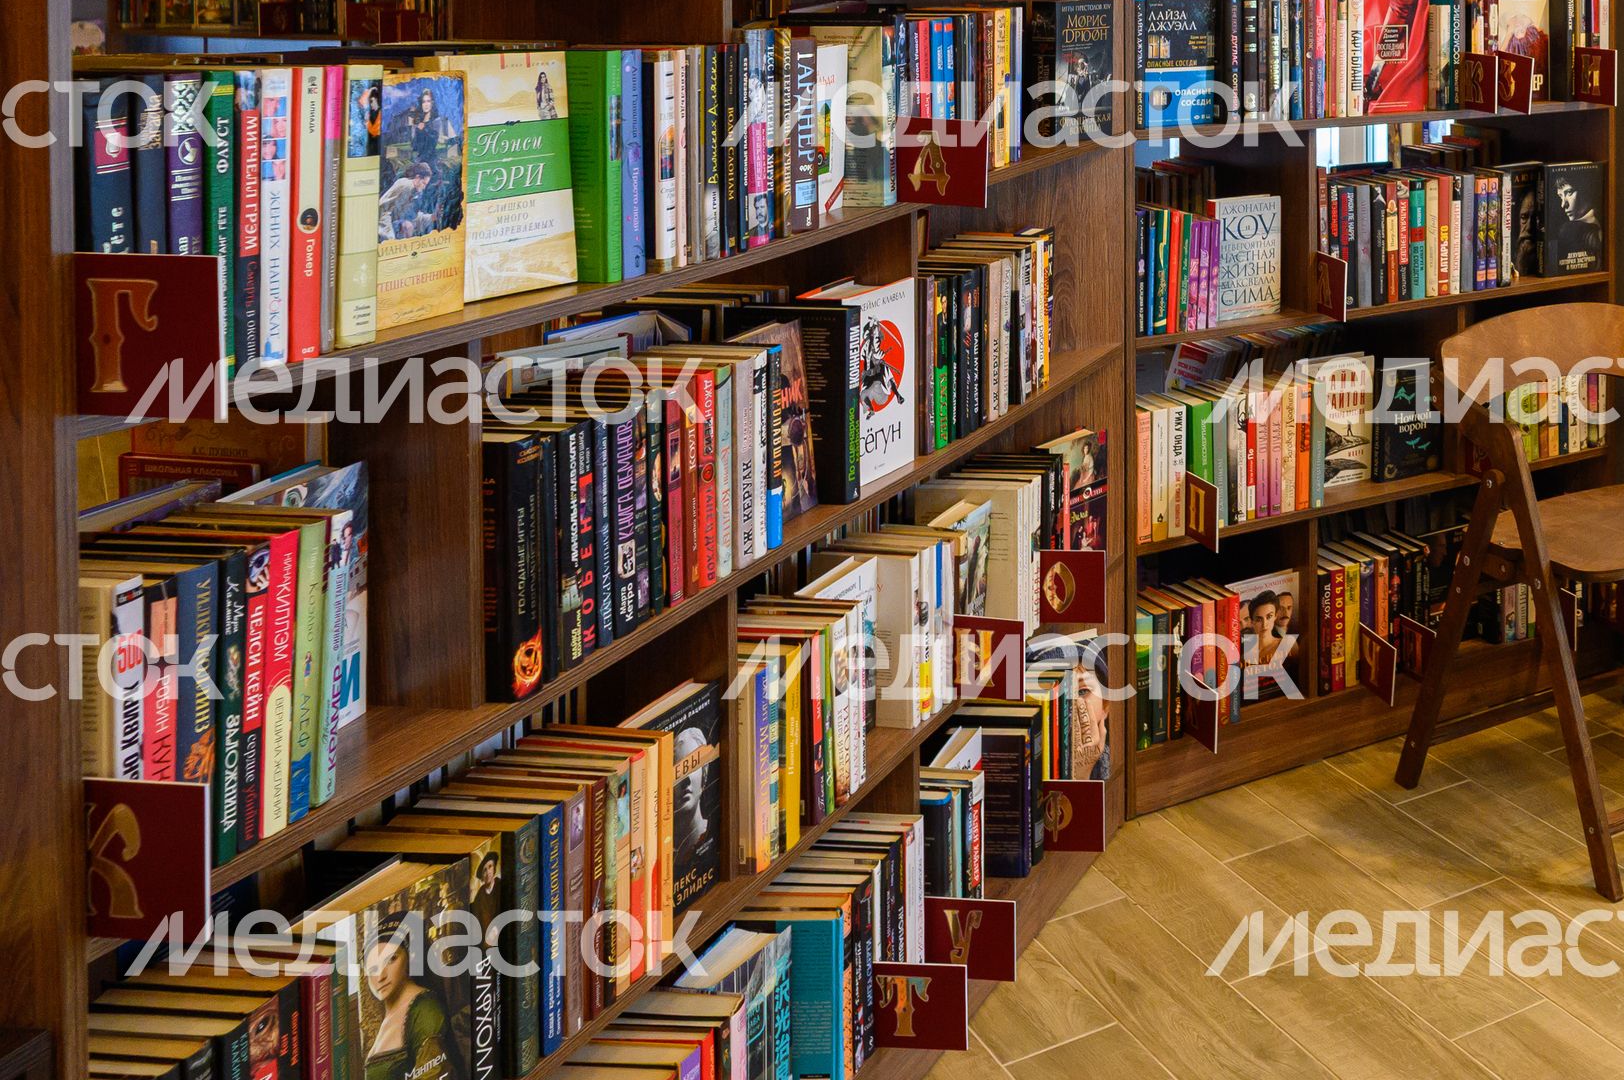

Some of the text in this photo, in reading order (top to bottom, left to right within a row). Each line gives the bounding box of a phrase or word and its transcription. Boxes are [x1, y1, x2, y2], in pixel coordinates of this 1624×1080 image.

[1147, 9, 1188, 22] ЛАЙЗА
[1147, 20, 1198, 33] ДЖУЭЛЛ
[1452, 3, 1461, 66] КОСМОПОЛИС
[1146, 59, 1198, 68] ОПАСНЫЕ СОСЕДИ
[1174, 88, 1212, 98] ОПАСНЫЕ
[1181, 98, 1212, 108] СОСЕДИ
[215, 117, 231, 175] ФАУСТ
[472, 131, 544, 157] Нэнси
[244, 114, 259, 251] МИТЧЕЛЛ ГРЭМ
[474, 163, 545, 195] ГЭРИ
[268, 189, 282, 250] ЖЕНИХ
[487, 199, 537, 215] СЛИШКОМ
[495, 212, 530, 226] МНОГО
[1221, 201, 1277, 215] ДЖОНАТАН
[471, 218, 555, 241] ПОДОЗРЕВАЕМЫХ
[1221, 213, 1277, 242] КОУ
[303, 238, 316, 277] Гомер
[1220, 239, 1277, 253] НЕВЕРОЯТНАЯ
[1221, 249, 1276, 265] ЧАСТНАЯ
[1220, 262, 1277, 279] ЖИЗНЬ
[1220, 286, 1276, 308] СИМА
[85, 278, 159, 393] Г
[1394, 409, 1432, 425] Ночной
[1399, 420, 1427, 434] ворон
[1175, 410, 1183, 457] РИКУ ОНДА
[688, 428, 697, 471] КОУЛ
[616, 419, 637, 541] КНИГА ОБМАНОВ
[742, 459, 754, 525] КЕРУАК
[283, 552, 293, 583] НИНА
[619, 586, 629, 615] Марта
[625, 582, 635, 623] Кетро
[246, 605, 265, 721] ЧЕЛСИ КЕЙН
[155, 674, 171, 732] РОБИН
[326, 663, 342, 771] КРАМЕР
[299, 693, 312, 748] АЛЕФ
[243, 733, 258, 783] сердце
[221, 714, 242, 834] ЗАЛОЖНИЦА
[875, 975, 933, 1037] Т
